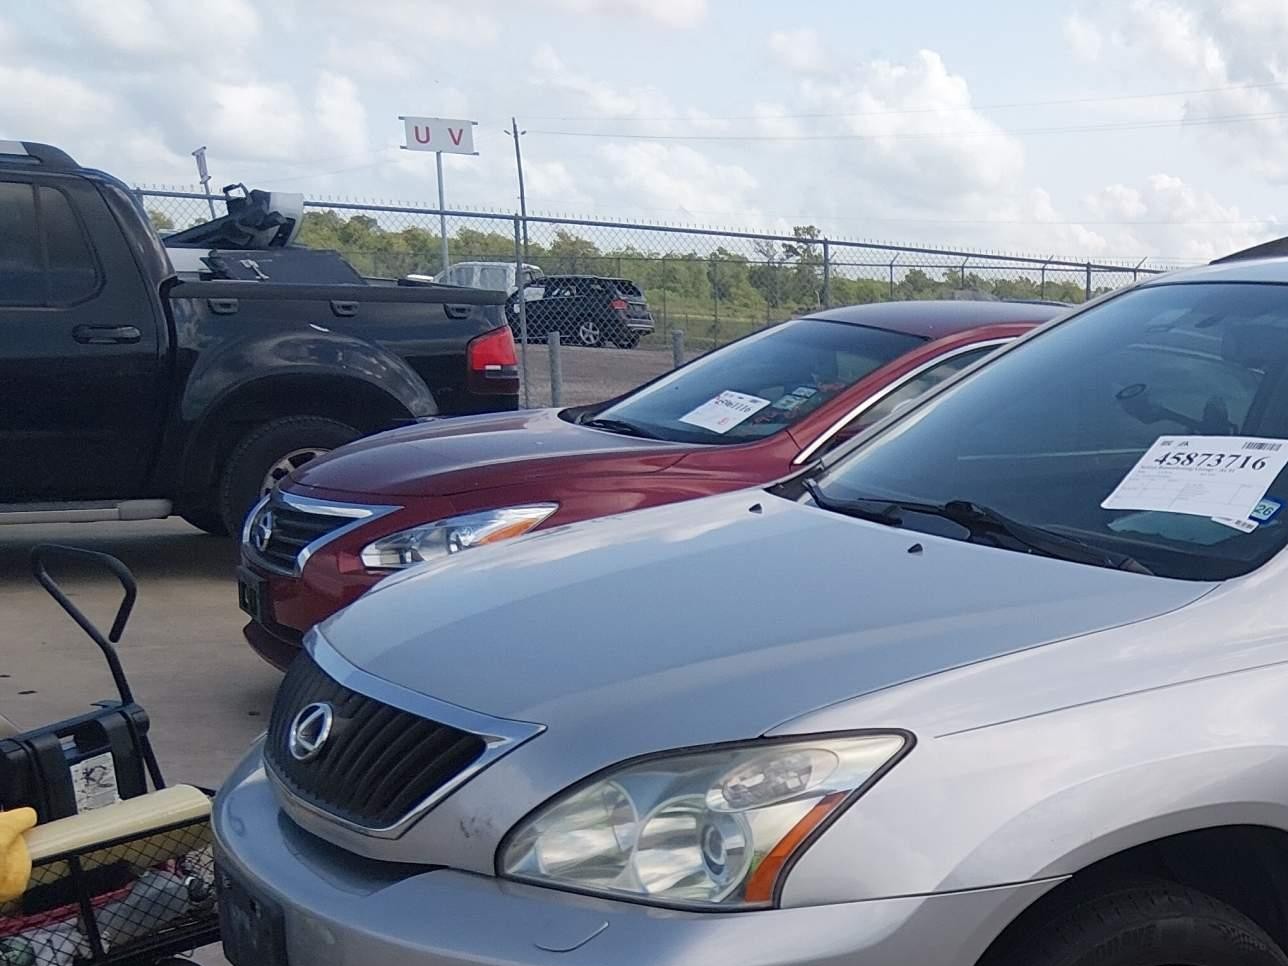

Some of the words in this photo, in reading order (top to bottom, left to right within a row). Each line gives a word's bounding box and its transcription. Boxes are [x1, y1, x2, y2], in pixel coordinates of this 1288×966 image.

[414, 125, 431, 144] U
[447, 127, 464, 146] V
[1155, 452, 1270, 471] 45873716
[1254, 504, 1274, 516] 26
